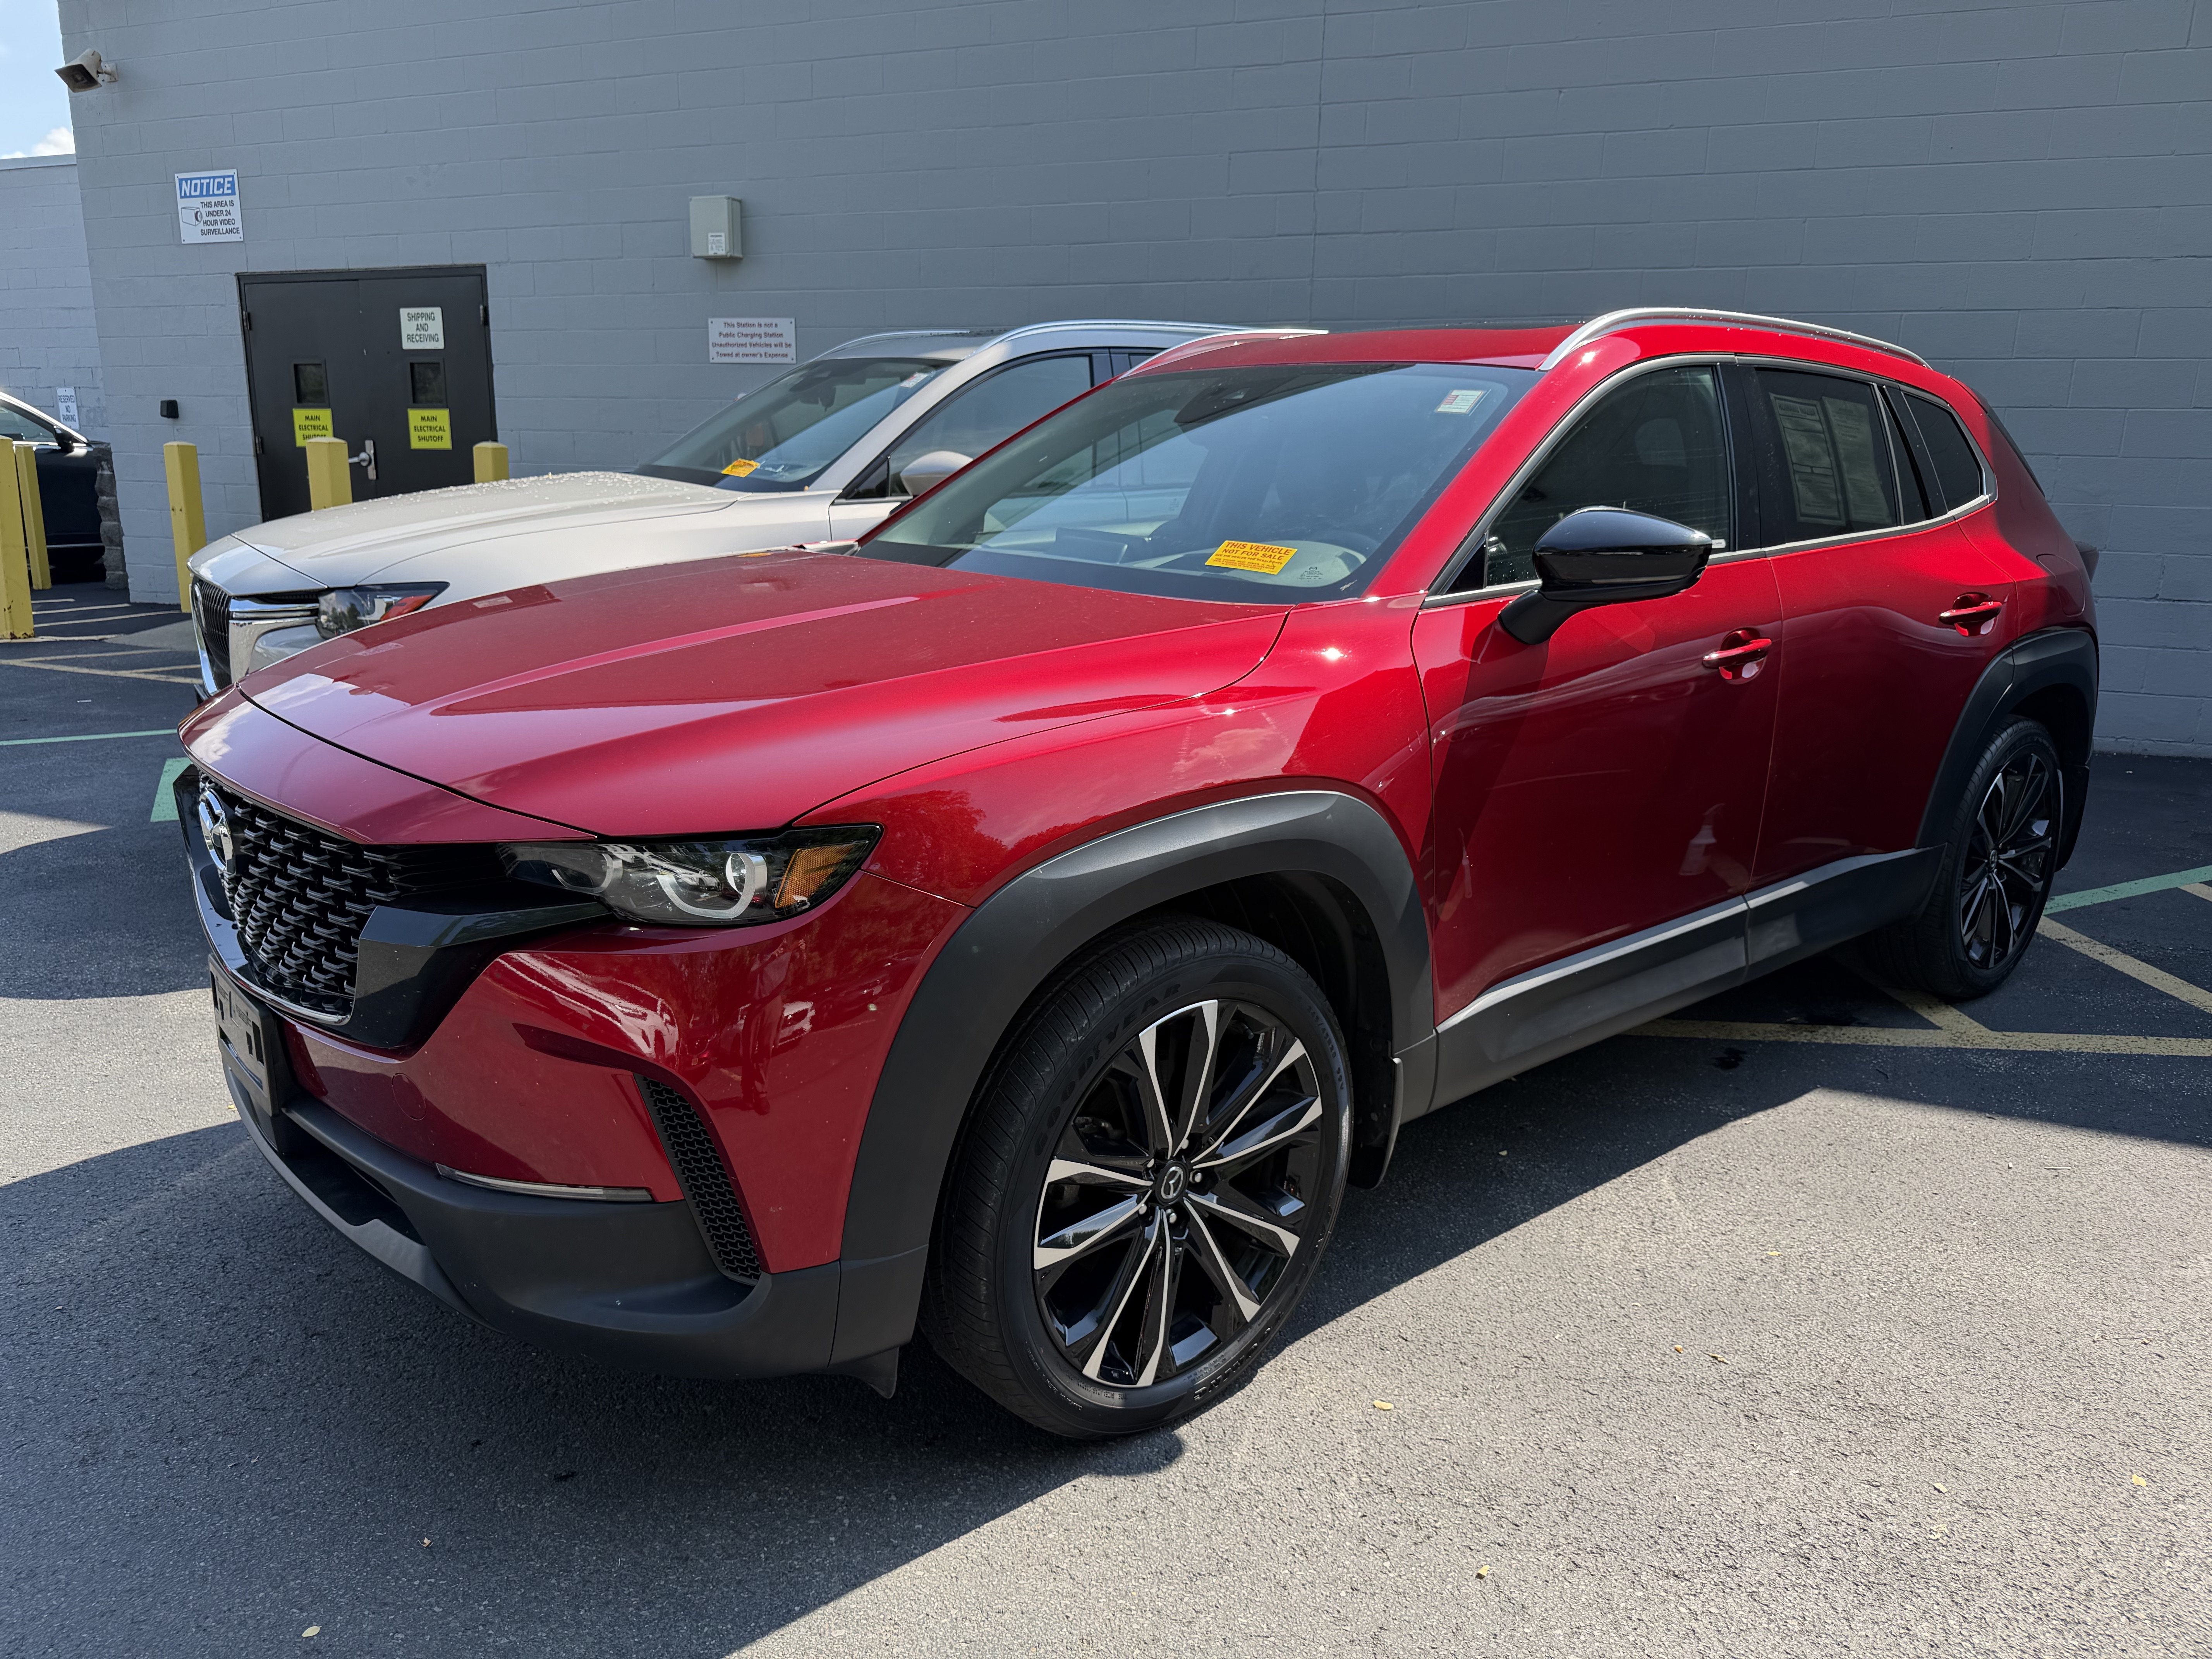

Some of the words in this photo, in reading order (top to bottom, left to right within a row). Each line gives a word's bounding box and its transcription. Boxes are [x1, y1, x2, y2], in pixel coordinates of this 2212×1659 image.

[181, 177, 232, 196] NOTICE
[200, 227, 240, 236] SURVEILLANCE
[407, 312, 435, 321] SHIPPING
[416, 323, 429, 332] AND
[407, 333, 439, 343] RECEIVING
[65, 405, 70, 413] NO
[62, 414, 76, 422] PARKING
[1249, 544, 1292, 555] VEHICLE
[1035, 984, 1180, 1156] GOODYEAR
